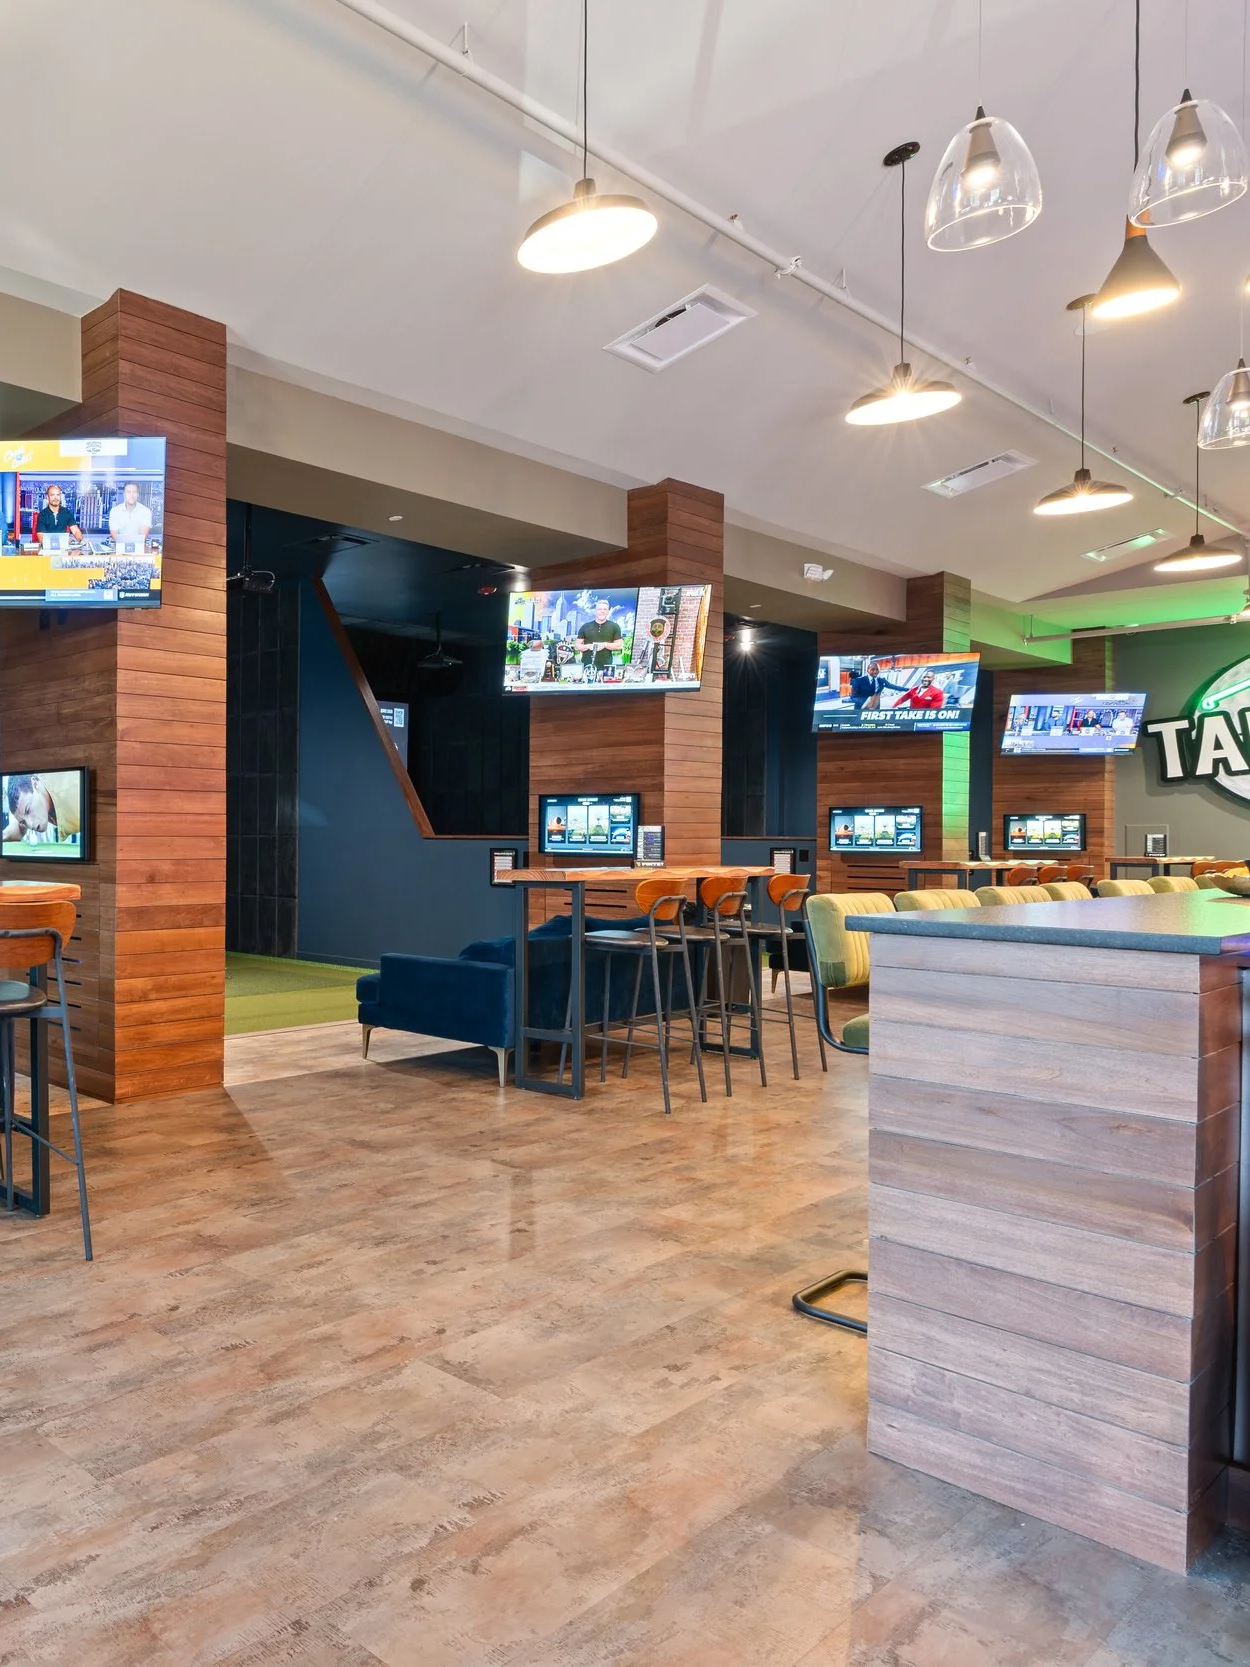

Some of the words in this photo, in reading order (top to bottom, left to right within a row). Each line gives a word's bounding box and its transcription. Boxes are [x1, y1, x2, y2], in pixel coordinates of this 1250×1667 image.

[860, 711, 894, 721] FIRST
[894, 711, 924, 720] TAKE
[924, 710, 937, 720] IS
[938, 710, 960, 719] ON!
[1147, 712, 1250, 779] TA
